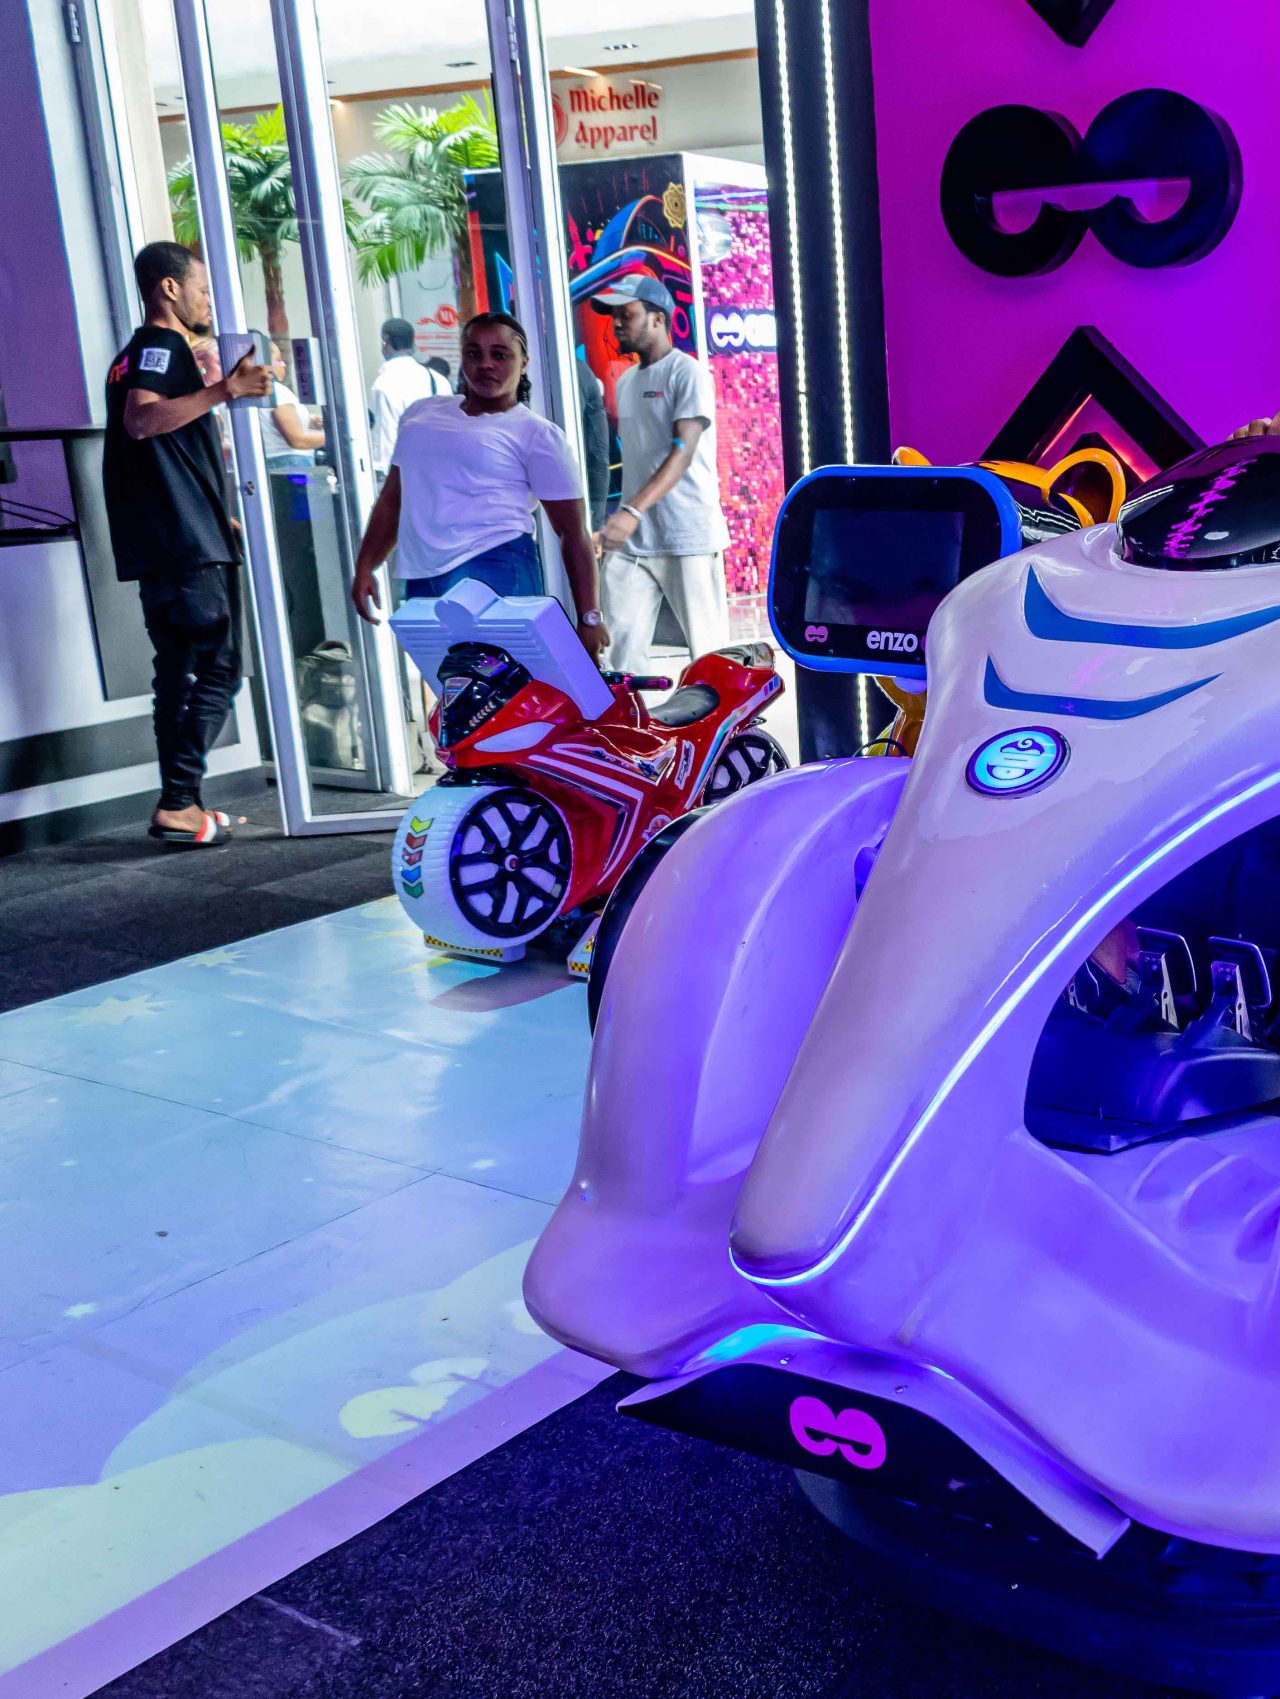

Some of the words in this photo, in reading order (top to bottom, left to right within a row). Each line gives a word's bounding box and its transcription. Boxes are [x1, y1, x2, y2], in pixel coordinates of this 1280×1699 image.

[568, 84, 659, 113] Michelle
[575, 115, 658, 149] Apparel
[866, 630, 918, 653] enzo
